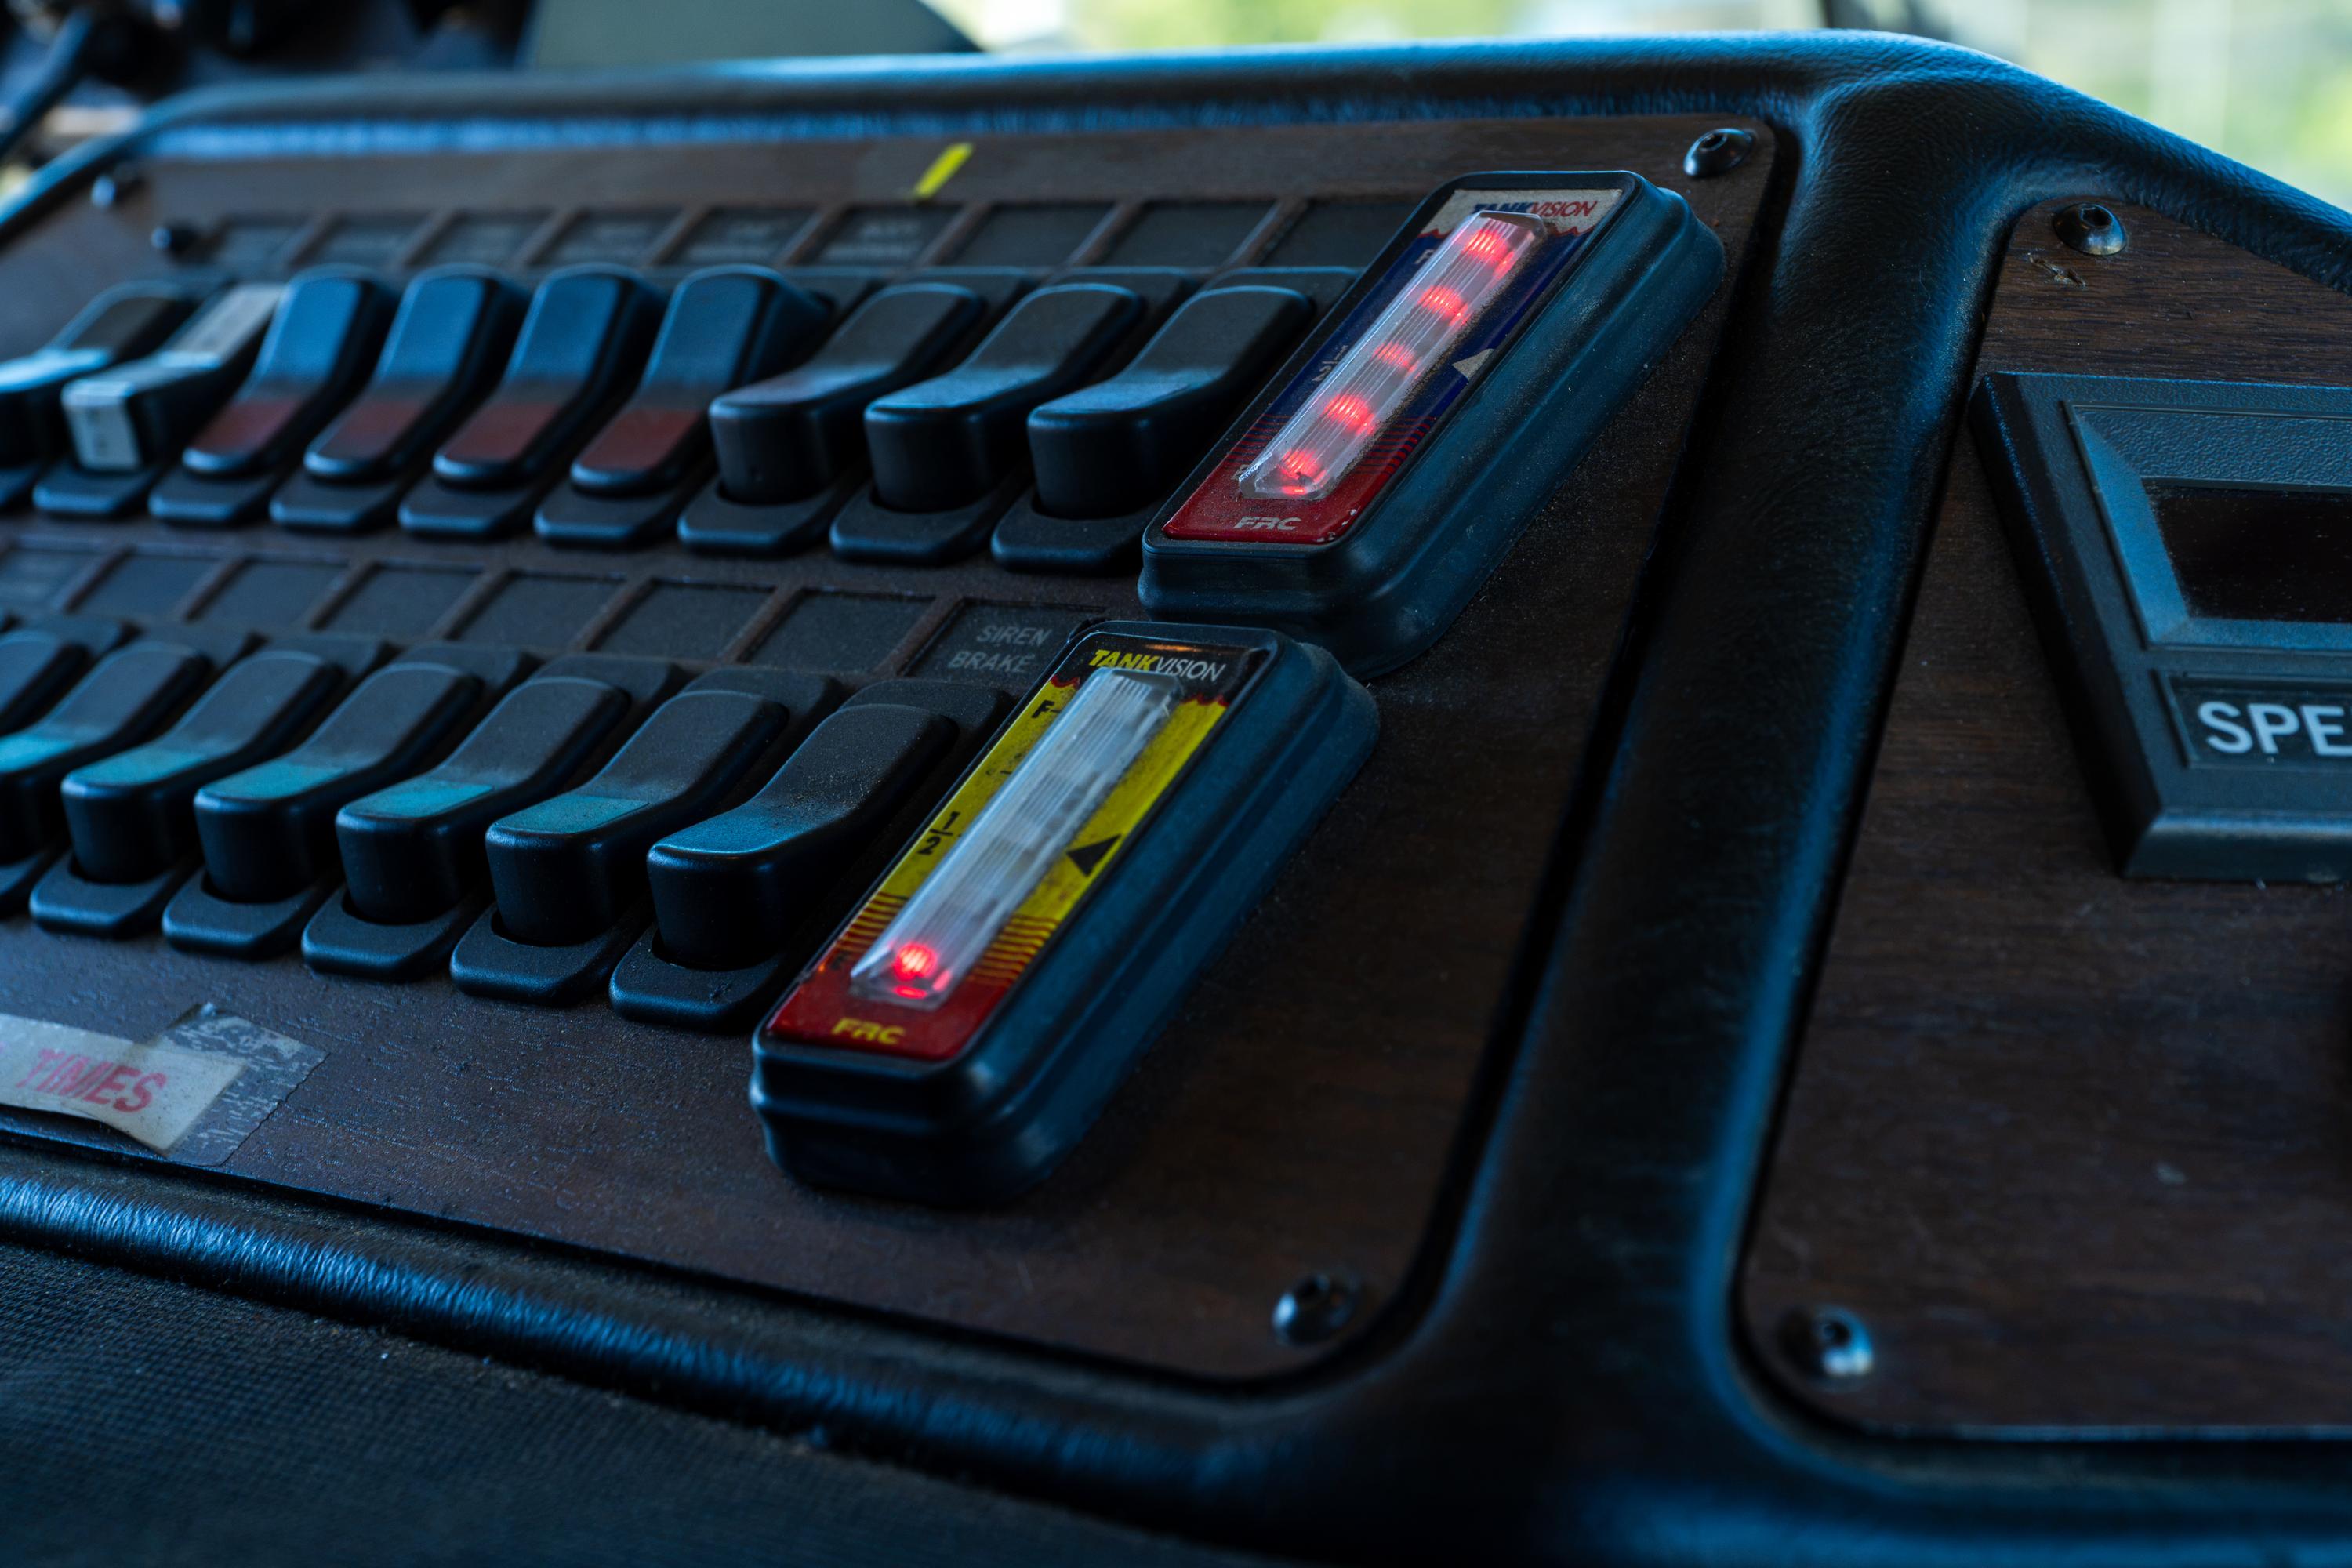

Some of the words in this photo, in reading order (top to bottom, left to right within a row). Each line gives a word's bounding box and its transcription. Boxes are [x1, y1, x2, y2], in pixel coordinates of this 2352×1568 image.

[1233, 517, 1301, 531] FRC
[976, 626, 1052, 646] SIREN
[947, 652, 1035, 673] BRAKE
[832, 1018, 905, 1044] FRC
[16, 1048, 167, 1113] TIMES
